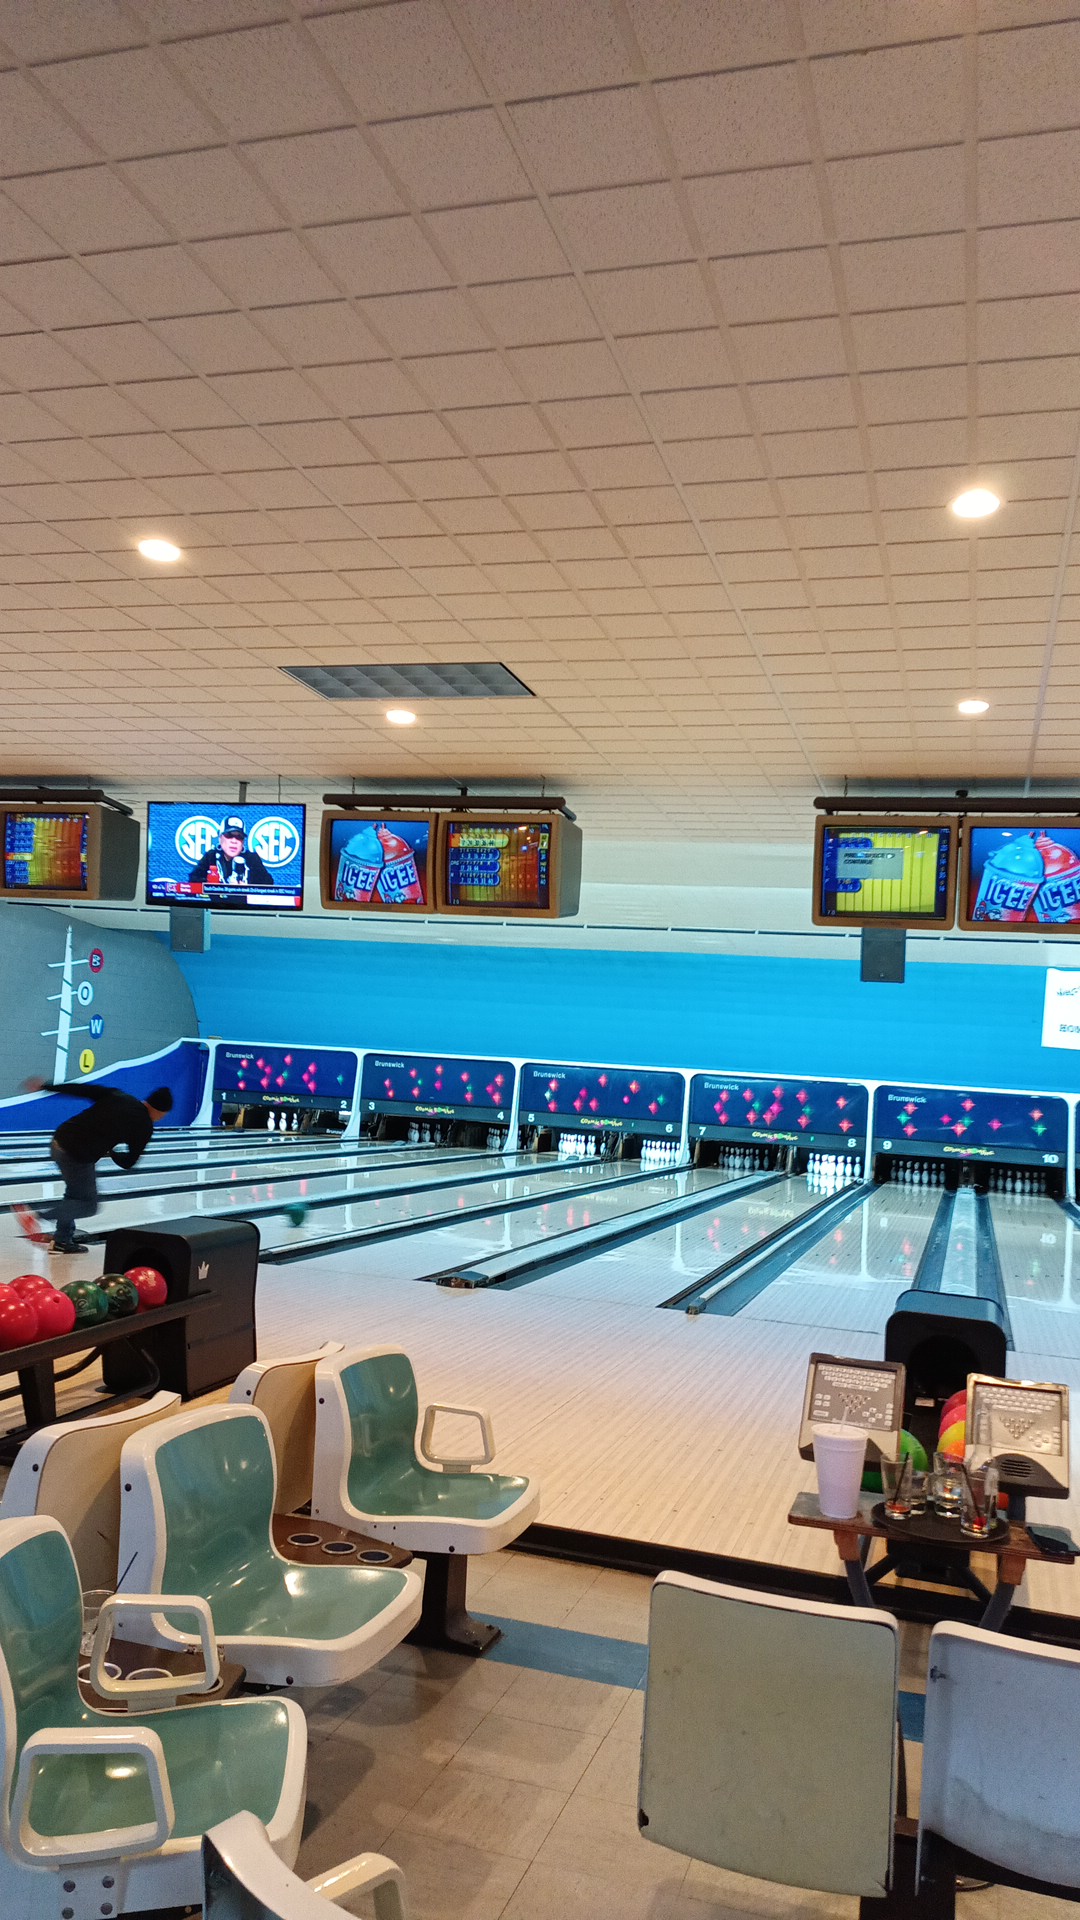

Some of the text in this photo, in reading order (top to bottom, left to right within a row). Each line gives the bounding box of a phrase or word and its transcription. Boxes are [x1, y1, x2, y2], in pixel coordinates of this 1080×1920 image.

[181, 822, 218, 861] SEC
[255, 822, 294, 862] SEC
[343, 861, 377, 892] ICEE
[380, 861, 416, 892] ICEE
[986, 875, 1034, 911] ICEE
[92, 954, 101, 967] B
[81, 986, 89, 1000] O
[91, 1019, 102, 1034] W
[83, 1053, 90, 1068] L
[225, 1051, 254, 1060] Brunswick
[374, 1060, 405, 1069] Brunswick
[533, 1070, 566, 1079] Brunswick
[704, 1081, 739, 1091] Brunswick
[221, 1092, 227, 1100] 1
[888, 1093, 927, 1103] Brunswick
[340, 1100, 347, 1109] 2
[368, 1102, 375, 1111] 3
[497, 1111, 504, 1120] 4
[528, 1113, 535, 1122] 5
[665, 1123, 673, 1133] 6
[699, 1126, 707, 1136] 7
[847, 1138, 857, 1148] 8
[883, 1140, 892, 1150] 9
[1042, 1153, 1059, 1164] 10
